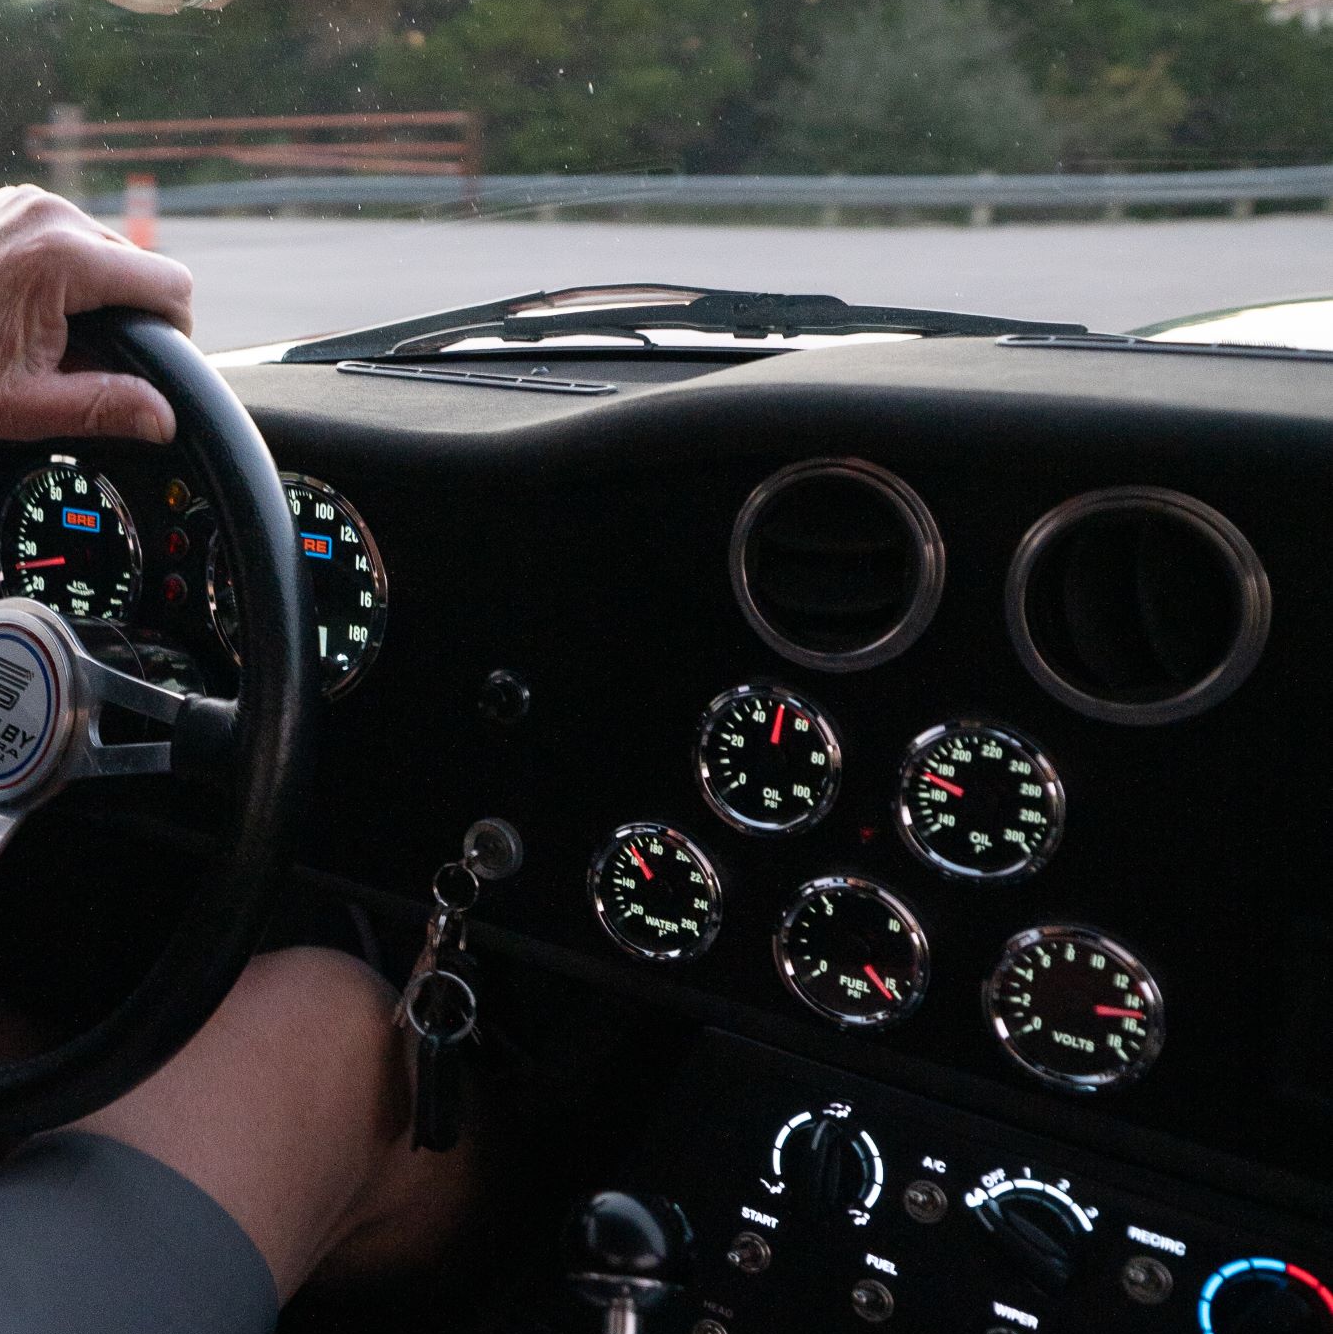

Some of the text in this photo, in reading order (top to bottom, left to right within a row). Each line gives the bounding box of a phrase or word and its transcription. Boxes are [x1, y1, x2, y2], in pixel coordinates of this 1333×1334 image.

[50, 486, 63, 501] 50
[75, 478, 87, 494] 60
[32, 507, 44, 522] 40
[315, 502, 334, 520] 100
[67, 512, 96, 527] BRE
[25, 540, 37, 556] 30
[303, 537, 327, 553] RE
[355, 554, 370, 572] 14
[32, 575, 45, 591] 20
[71, 598, 89, 612] RPM
[360, 590, 372, 608] 16
[348, 623, 368, 643] 180
[752, 709, 766, 723] 40
[794, 718, 809, 732] 60
[730, 734, 745, 748] 20
[810, 750, 826, 766] 80
[951, 748, 972, 763] 200
[980, 744, 1003, 760] 220
[937, 762, 955, 778] 180
[1008, 759, 1032, 776] 240
[738, 772, 747, 785] 0
[762, 787, 783, 802] OIL
[792, 783, 811, 799] 100
[929, 788, 948, 803] 160
[1019, 782, 1043, 798] 260
[764, 799, 778, 809] PSI
[937, 812, 956, 827] 140
[1019, 808, 1042, 824] 280
[969, 830, 993, 847] OIL
[1003, 828, 1026, 844] 300
[649, 843, 664, 856] 180
[622, 876, 636, 889] 140
[690, 871, 704, 885] 22
[630, 902, 644, 916] 120
[825, 903, 834, 916] 5
[645, 914, 679, 933] WATER
[681, 917, 698, 931] 260
[888, 918, 901, 933] 10
[1041, 953, 1051, 969] 6
[1065, 946, 1076, 962] 8
[1090, 953, 1106, 970] 10
[819, 959, 828, 973] 0
[1024, 968, 1034, 982] 4
[1113, 973, 1130, 990] 12
[839, 974, 871, 994] FUEL
[885, 976, 897, 991] 15
[847, 988, 862, 999] PSI
[1021, 992, 1032, 1008] 2
[1032, 1016, 1042, 1031] 0
[1122, 1017, 1138, 1033] 16
[1052, 1030, 1095, 1053] VOLTS
[1106, 1033, 1123, 1048] 18
[980, 1167, 1006, 1189] OFF
[741, 1205, 780, 1229] START
[1127, 1224, 1187, 1257] RECIRC
[865, 1252, 898, 1276] FUEL
[703, 1298, 735, 1319] HEAD
[993, 1300, 1039, 1330] WIPER
